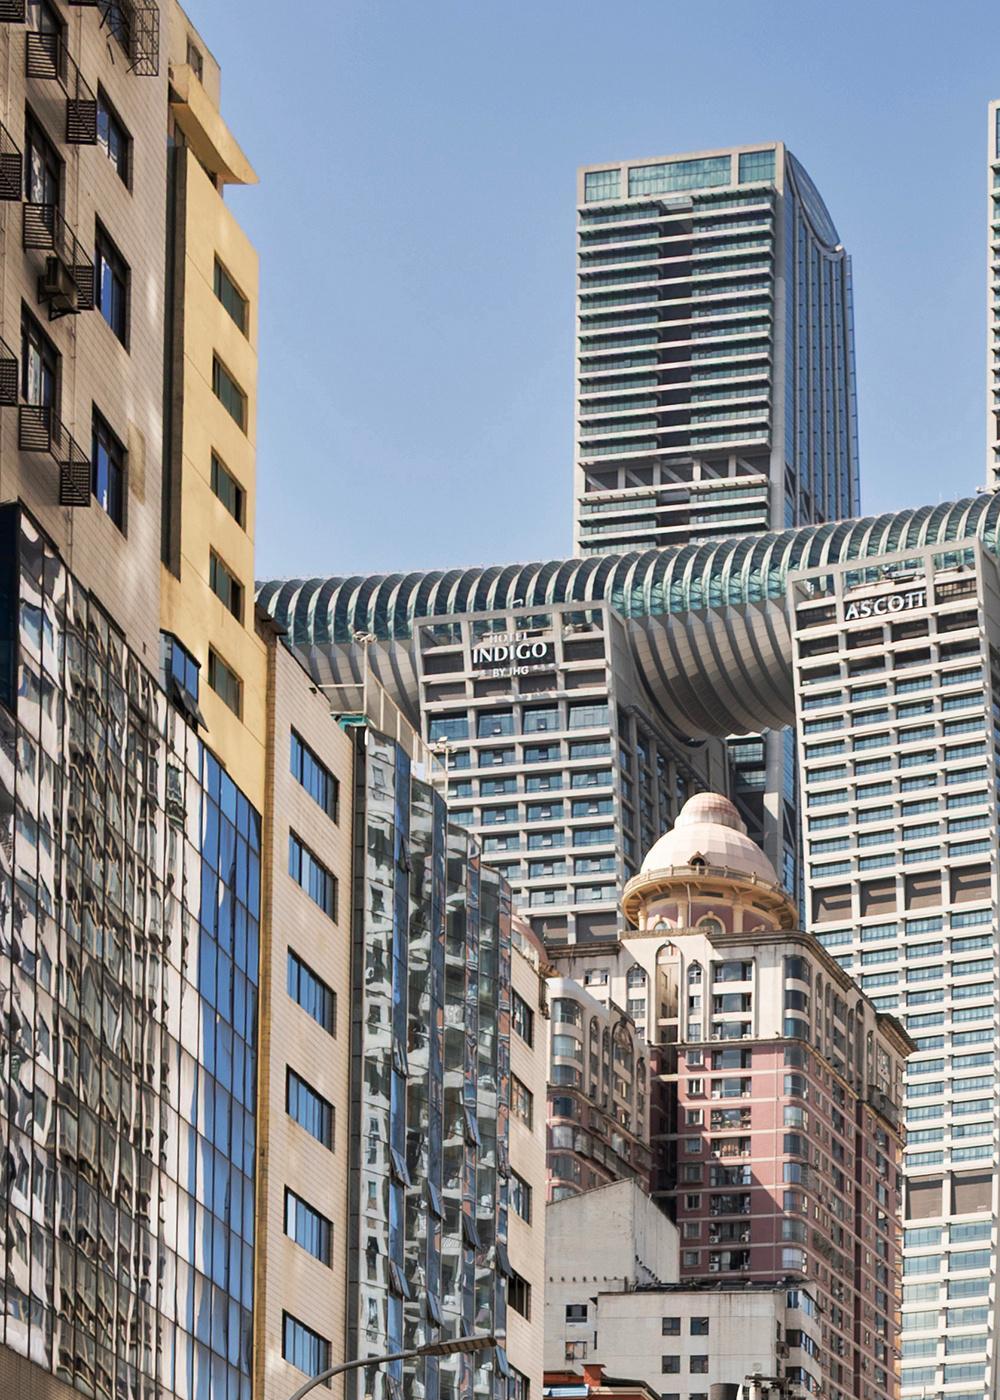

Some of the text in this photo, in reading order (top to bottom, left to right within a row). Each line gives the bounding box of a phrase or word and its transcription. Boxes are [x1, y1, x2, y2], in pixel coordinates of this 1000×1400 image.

[845, 590, 926, 620] ASCOTT
[489, 631, 529, 643] HOTEL
[473, 641, 547, 664] INDIGO
